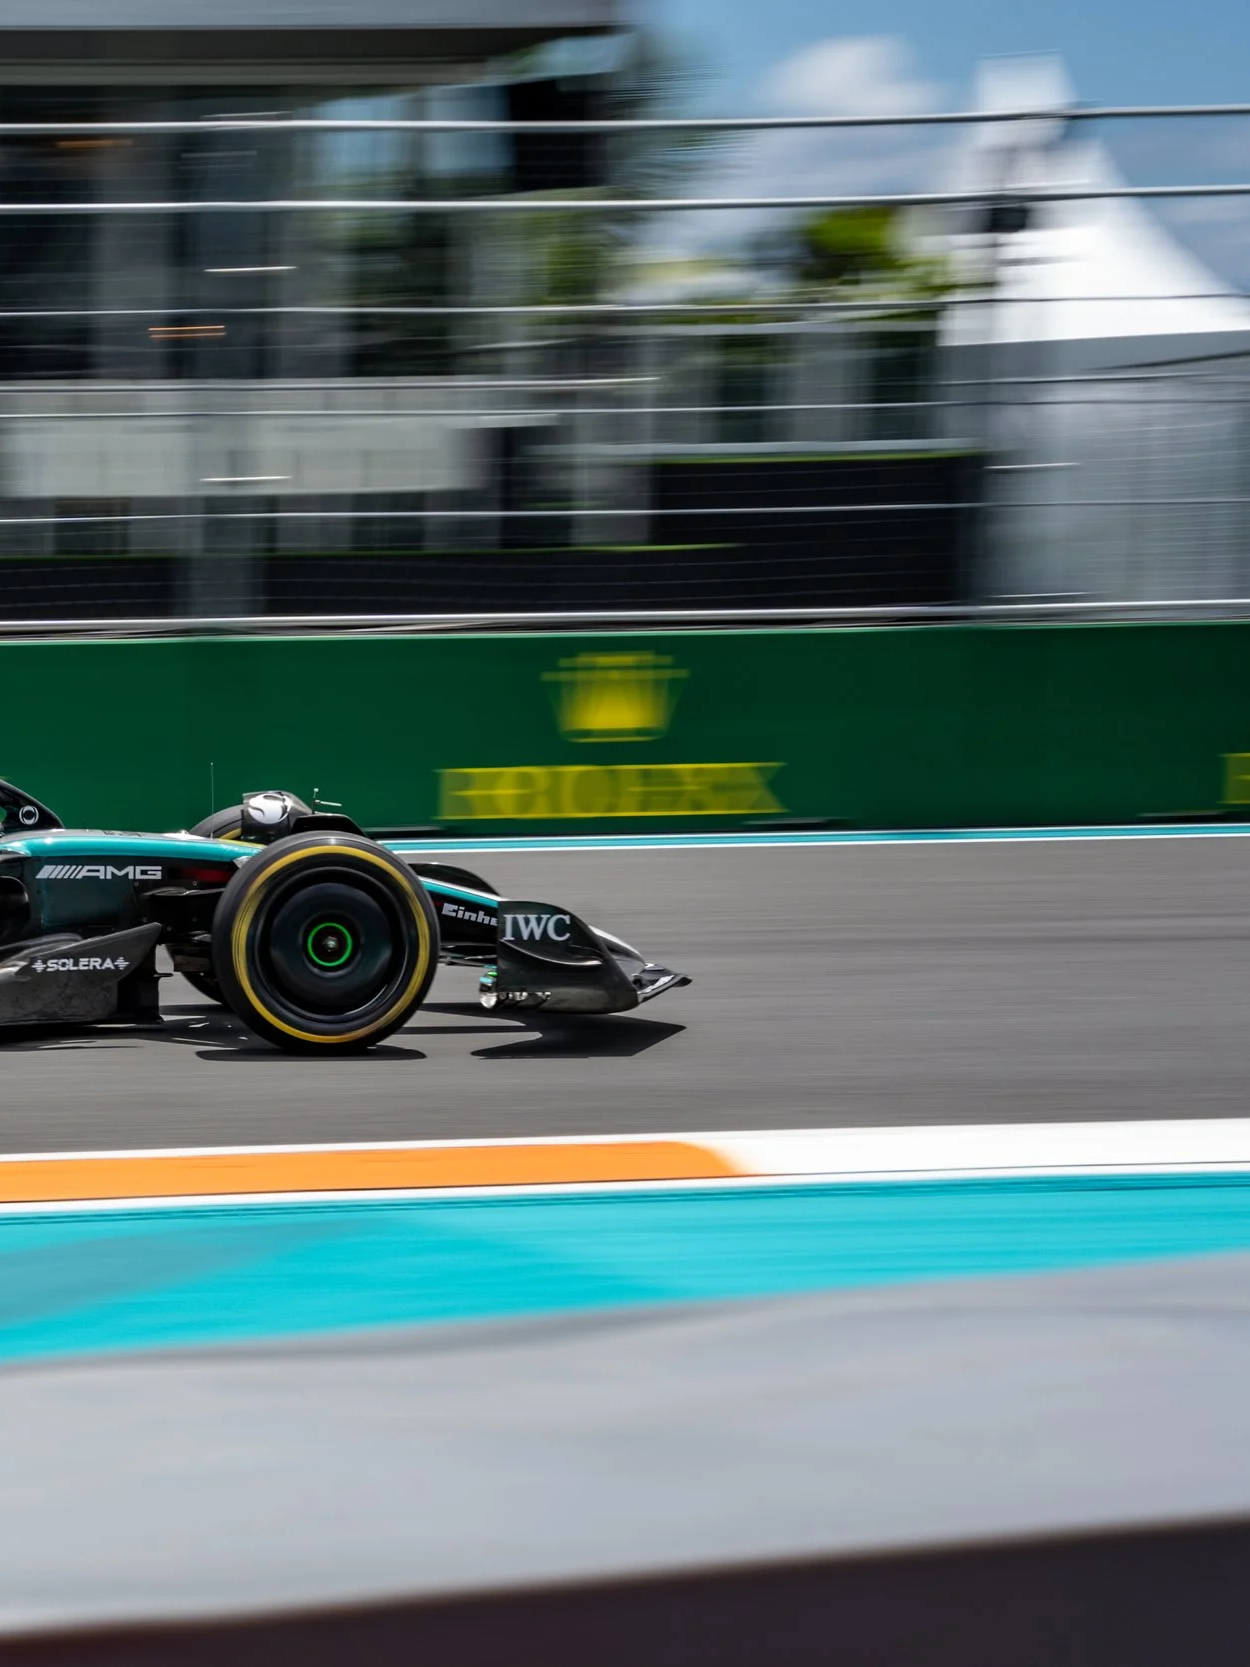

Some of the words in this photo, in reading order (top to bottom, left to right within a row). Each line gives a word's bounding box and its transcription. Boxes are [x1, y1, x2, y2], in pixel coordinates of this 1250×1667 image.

[78, 866, 162, 880] AMG
[502, 914, 571, 941] IWC
[46, 957, 114, 972] SOLERA
